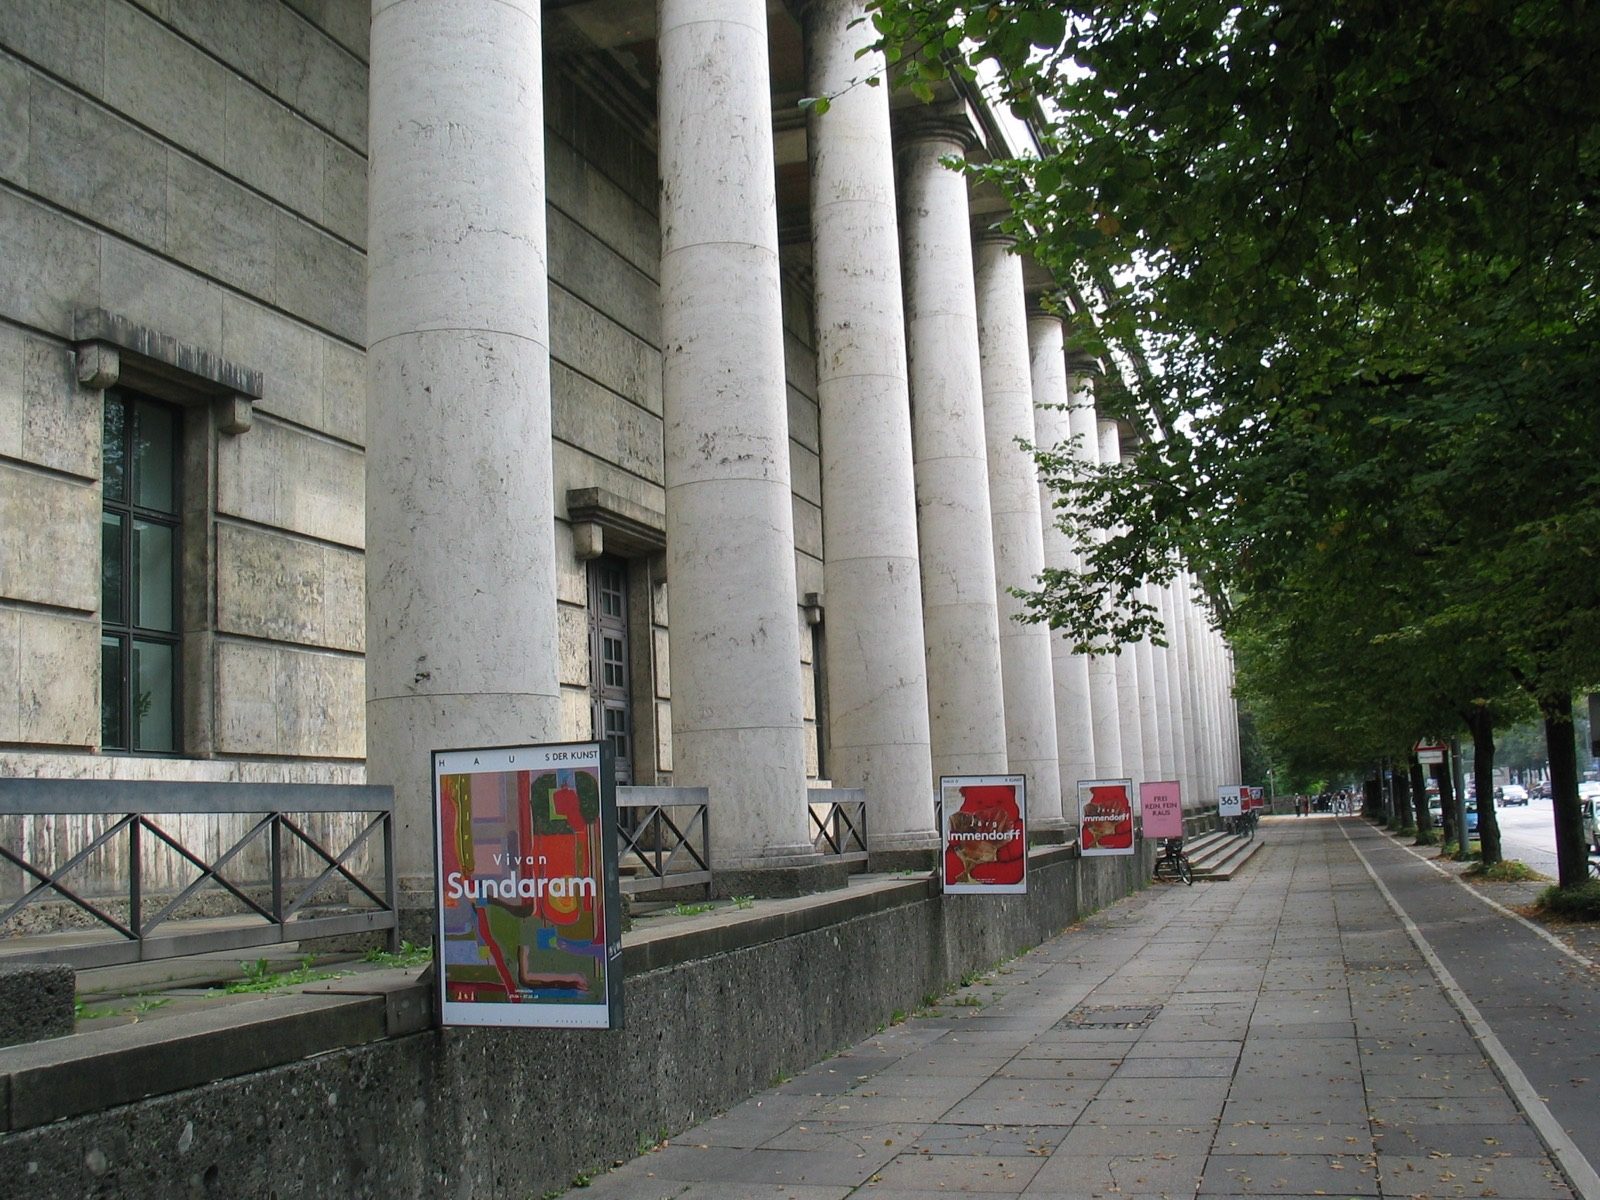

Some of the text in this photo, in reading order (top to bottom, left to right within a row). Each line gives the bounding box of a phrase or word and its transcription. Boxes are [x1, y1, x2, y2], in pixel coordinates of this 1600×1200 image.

[552, 751, 568, 761] DER
[571, 750, 598, 760] KUNST
[1221, 795, 1239, 806] 363
[1082, 812, 1130, 822] Immendorff
[947, 829, 1021, 841] Immendorff
[493, 853, 547, 866] Vivan
[447, 870, 597, 899] Sundaram
